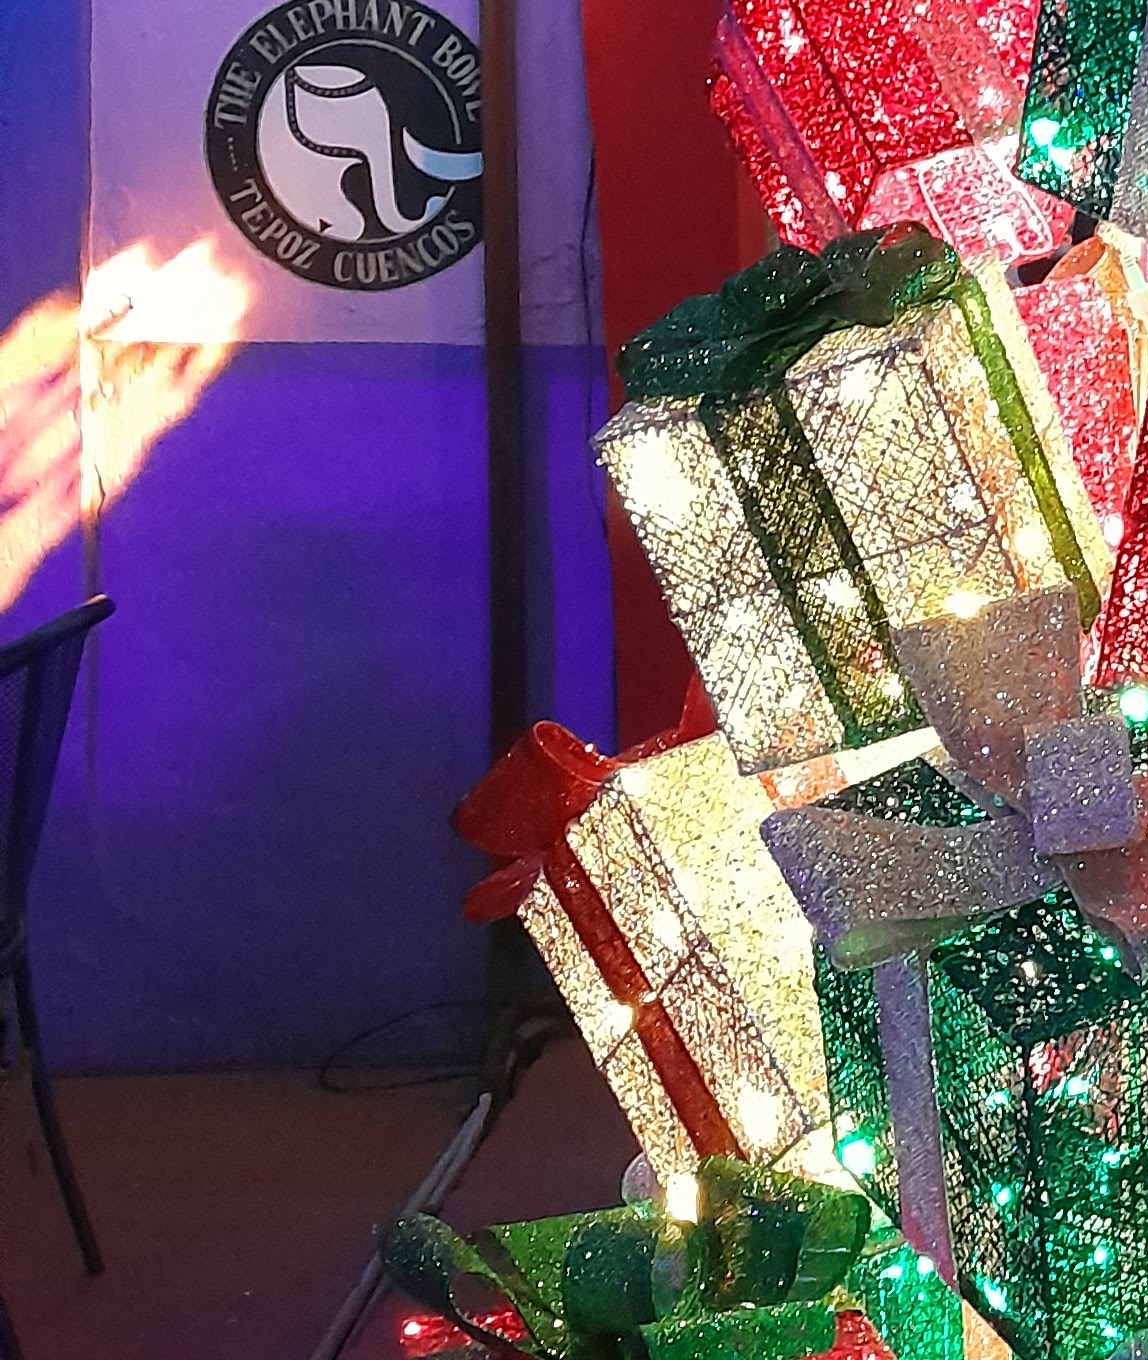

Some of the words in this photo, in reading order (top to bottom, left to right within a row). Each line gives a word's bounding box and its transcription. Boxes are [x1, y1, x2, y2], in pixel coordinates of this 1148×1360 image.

[215, 62, 262, 129] THE
[230, 179, 320, 269] TEPOZ
[334, 209, 475, 283] CUENCOS
